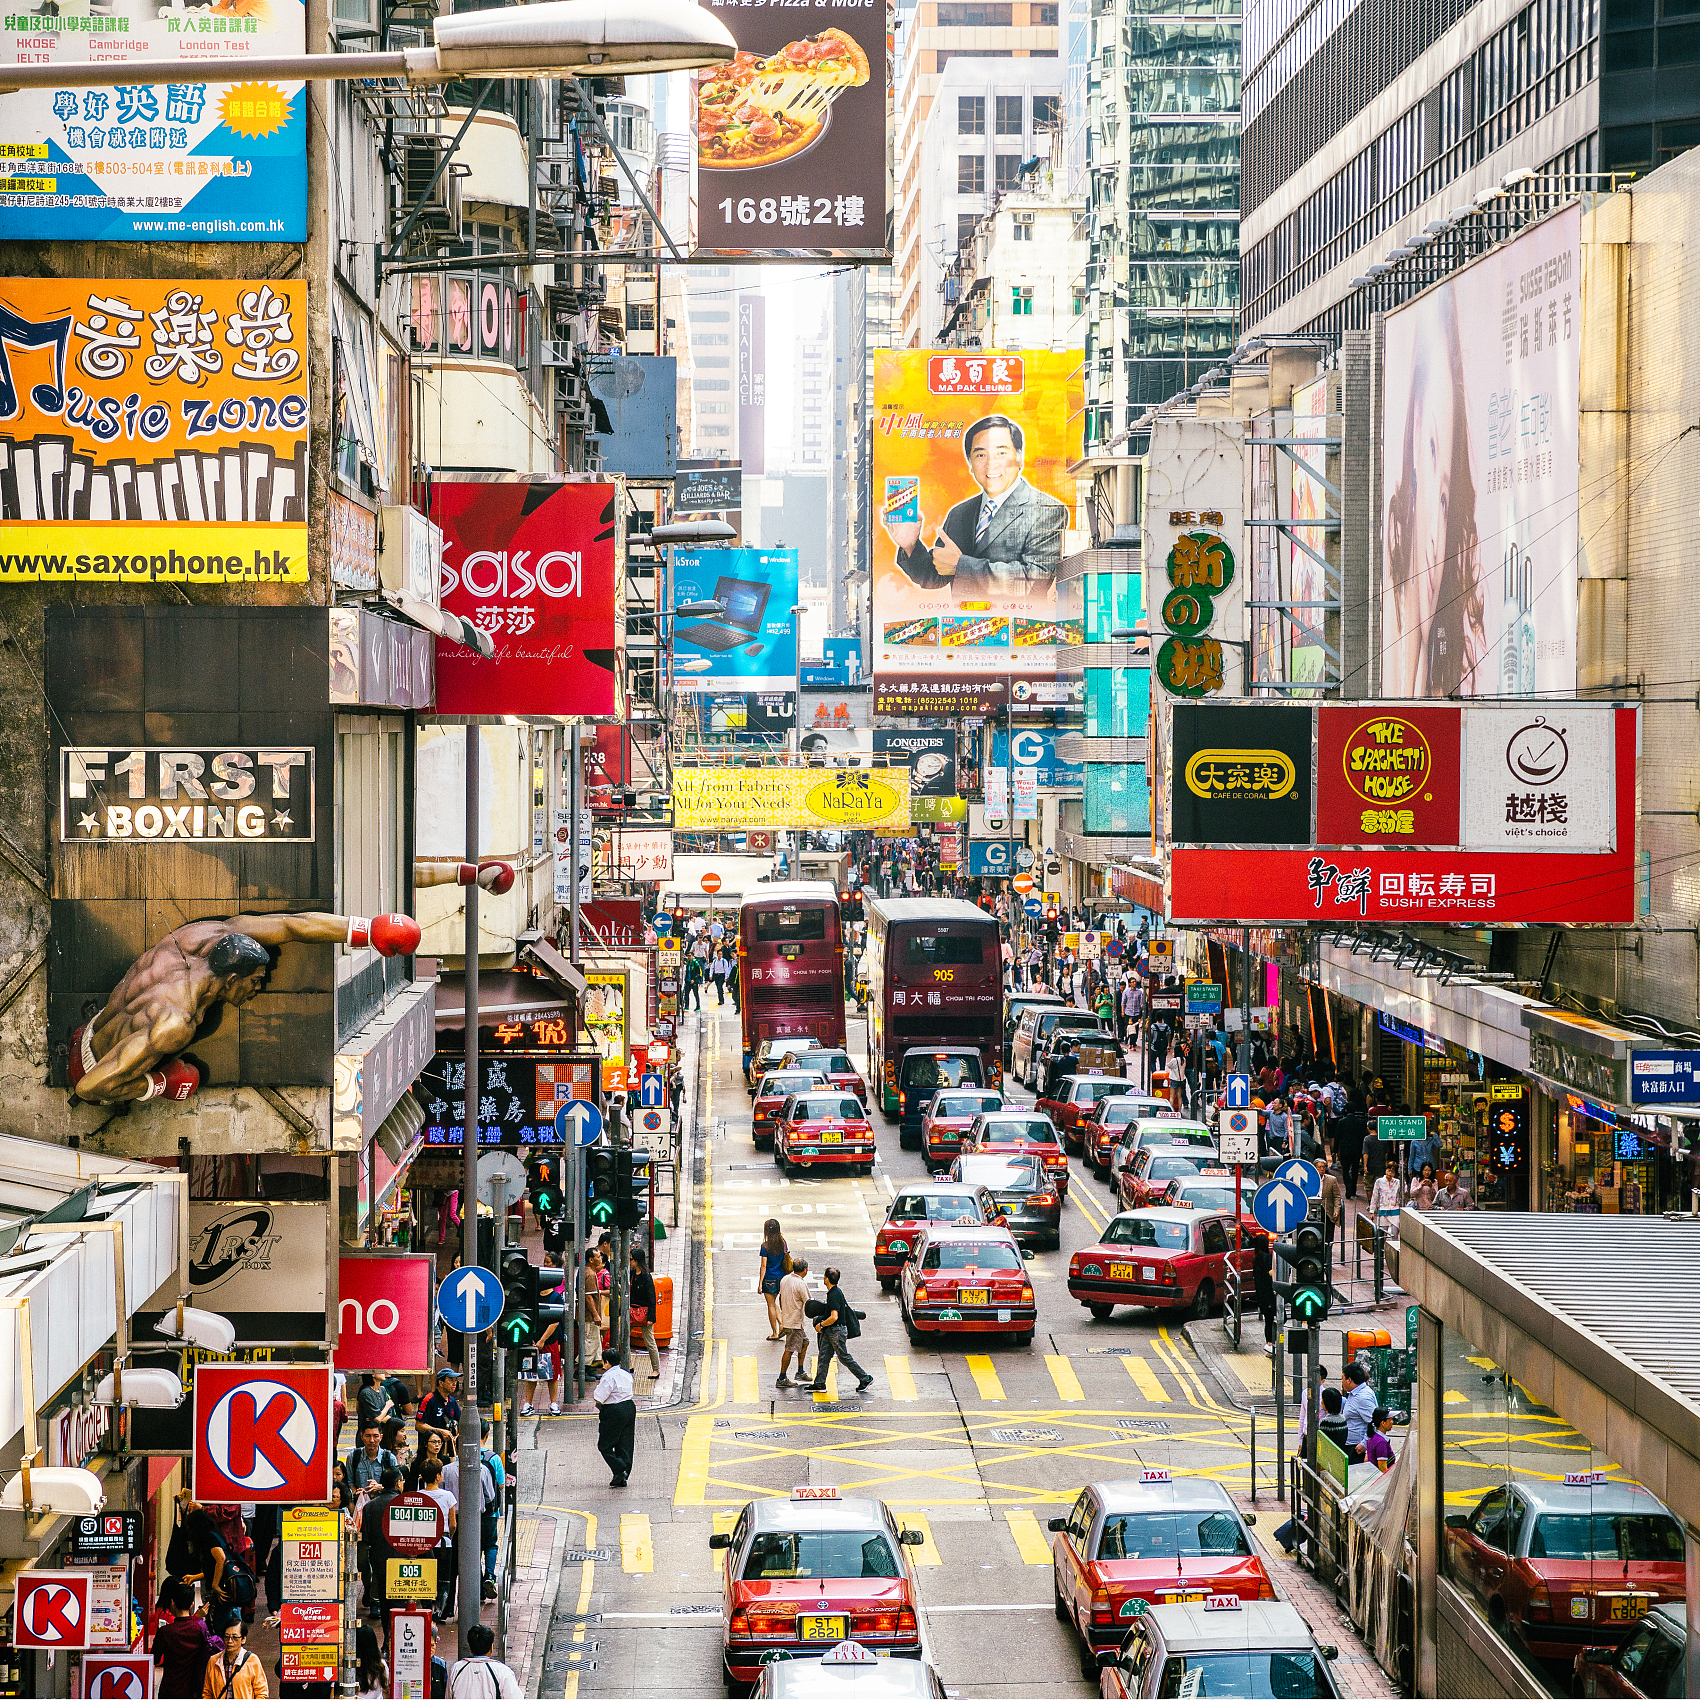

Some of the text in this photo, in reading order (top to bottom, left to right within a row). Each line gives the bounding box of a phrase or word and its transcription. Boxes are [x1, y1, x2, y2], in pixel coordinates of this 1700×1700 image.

[4, 16, 130, 33] 兒童及中小學英語課程
[167, 17, 258, 34] 成人英語課程
[16, 39, 56, 48] HKDSE
[89, 40, 149, 51] Cambridge
[179, 41, 250, 50] London Test
[17, 54, 51, 63] IELTS
[53, 83, 207, 125] 學好英語
[229, 101, 281, 119] 保證合格
[67, 127, 188, 149] 機會就在附近
[718, 195, 865, 226] 168號2樓
[133, 219, 285, 234] www.me-english.com.hk
[739, 303, 749, 406] GALA PLACE
[938, 357, 1013, 384] 馬百良
[979, 384, 1012, 392] LEUNG
[879, 412, 925, 436] 中風
[515, 644, 574, 667] beautiful
[1366, 722, 1405, 745] THE
[886, 738, 944, 747] LONGINES
[1011, 730, 1045, 766] G
[1350, 745, 1426, 773] SPAGHETTI
[68, 751, 306, 800] F1RST
[700, 778, 733, 794] from
[739, 781, 791, 791] Fabrics
[1363, 774, 1414, 800] HOUSE
[715, 798, 748, 808] Your
[751, 798, 791, 808] Needs
[822, 791, 883, 810] NaRaYa
[1505, 793, 1569, 825] 越棧
[106, 805, 266, 838] BOXING
[985, 843, 1007, 865] G
[1379, 899, 1496, 907] SUSHI EXPRESS
[751, 967, 790, 980] 周大福
[933, 969, 954, 982] 905
[892, 991, 941, 1006] 周大福
[1674, 1061, 1692, 1074] 商場
[1641, 1081, 1685, 1092] 快富街入口
[1499, 1112, 1516, 1133] $
[1243, 1138, 1251, 1146] 7
[658, 1150, 668, 1158] 12
[1244, 1152, 1256, 1160] 12
[1499, 1145, 1515, 1165] ¥
[712, 1203, 845, 1216] STOP
[241, 1261, 271, 1270] BOX
[225, 1388, 311, 1485] K
[1143, 1471, 1169, 1480] TAXI
[795, 1489, 837, 1498] TAXI
[394, 1508, 411, 1521] 904
[417, 1510, 434, 1520] 905
[83, 1521, 95, 1531] SF
[300, 1543, 321, 1558] E21A
[402, 1565, 419, 1578] 905
[1209, 1598, 1239, 1607] TAXI
[31, 1587, 79, 1641] K
[292, 1607, 327, 1617] Cityflyer
[814, 1618, 832, 1628] ST
[808, 1628, 839, 1638] 2621
[283, 1654, 299, 1665] E21
